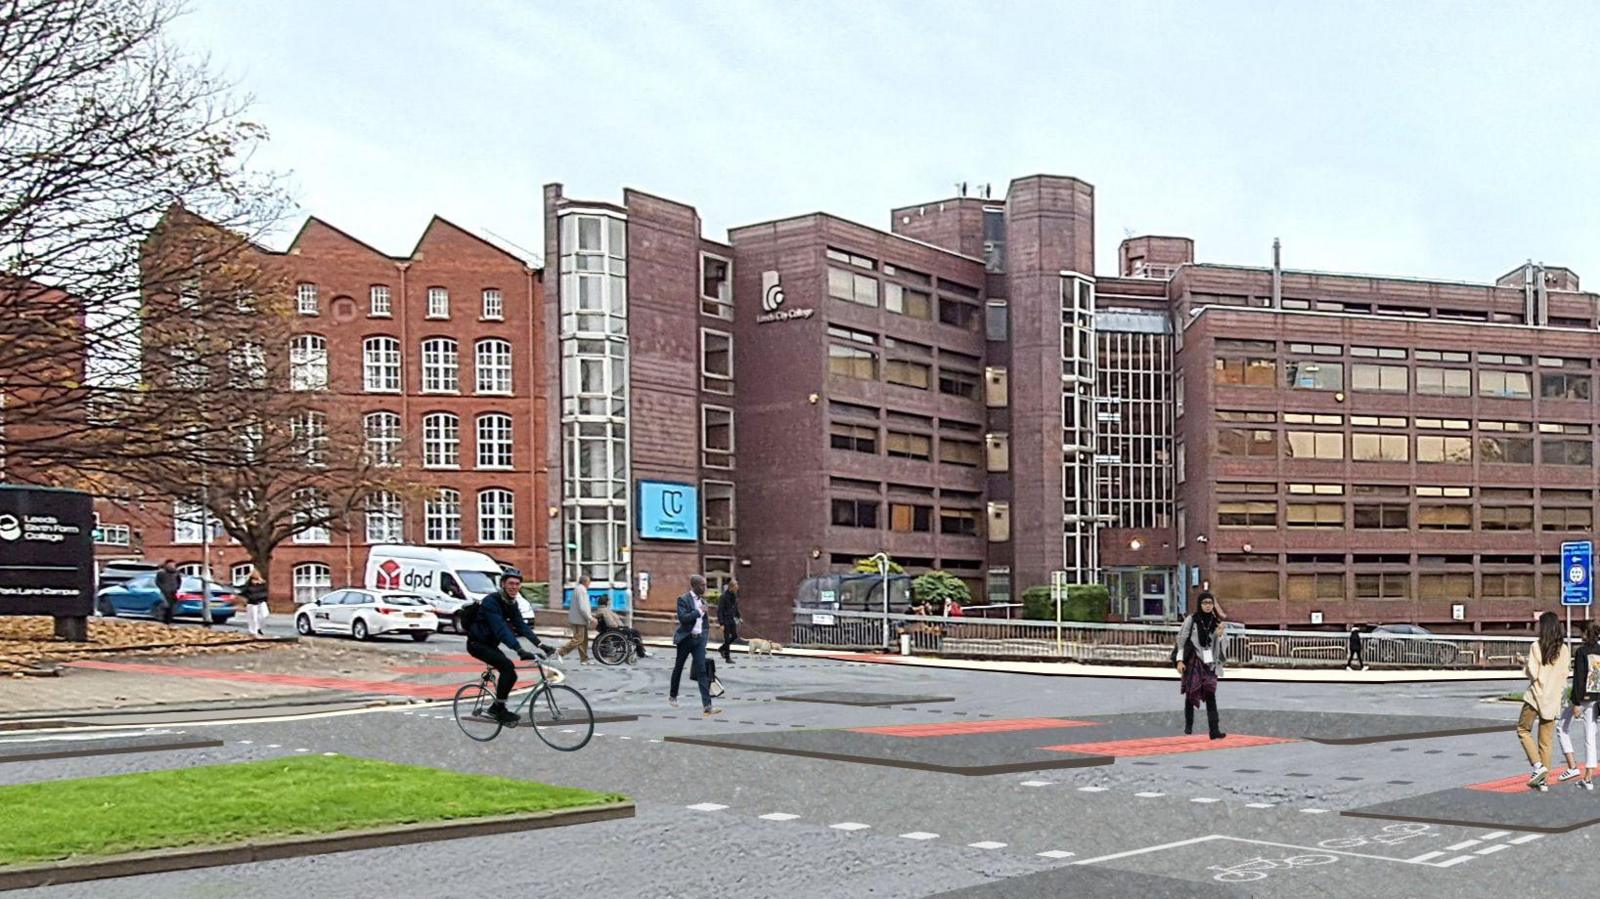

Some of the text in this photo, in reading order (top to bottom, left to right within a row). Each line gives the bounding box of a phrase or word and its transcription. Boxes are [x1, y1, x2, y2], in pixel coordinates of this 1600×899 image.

[24, 515, 57, 523] Leeds
[24, 532, 64, 541] College
[404, 568, 433, 591] dpd
[18, 587, 42, 595] Lane
